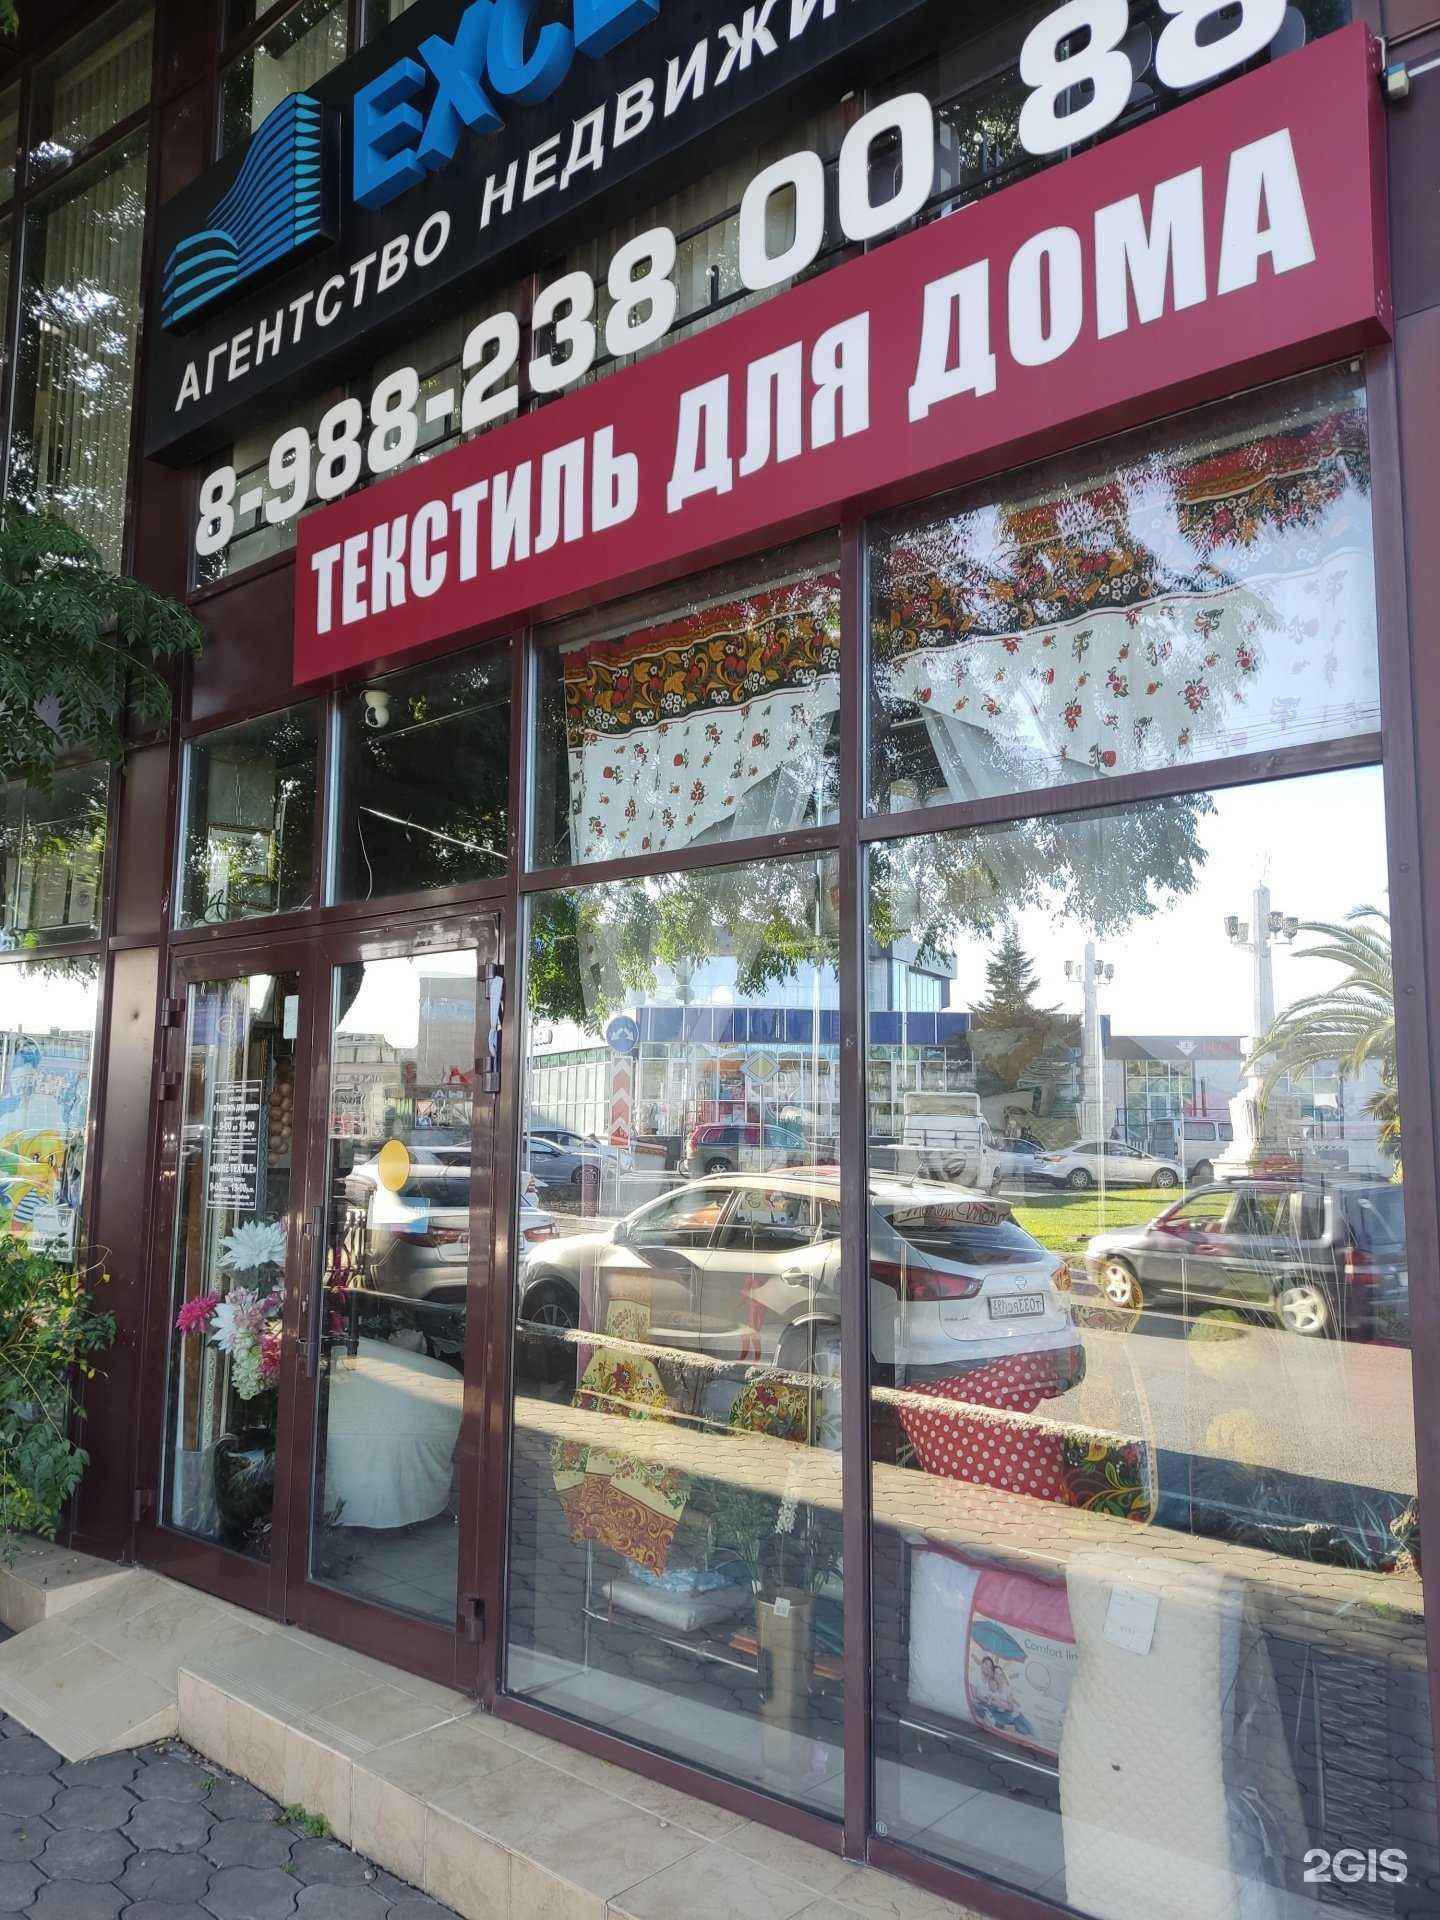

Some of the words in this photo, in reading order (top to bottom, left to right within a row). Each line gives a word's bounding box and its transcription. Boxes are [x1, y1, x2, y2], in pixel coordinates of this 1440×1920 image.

[175, 211, 450, 411] АГЕНТСТВО
[195, 227, 678, 557] 8-988-238
[739, 92, 935, 291] 00
[1019, 0, 1287, 155] 88
[312, 425, 638, 633] ТЕКСТИЛЬ
[666, 311, 869, 513] ДЛЯ
[909, 128, 1315, 422] ДОМА
[1024, 1638, 1063, 1659] Comfort
